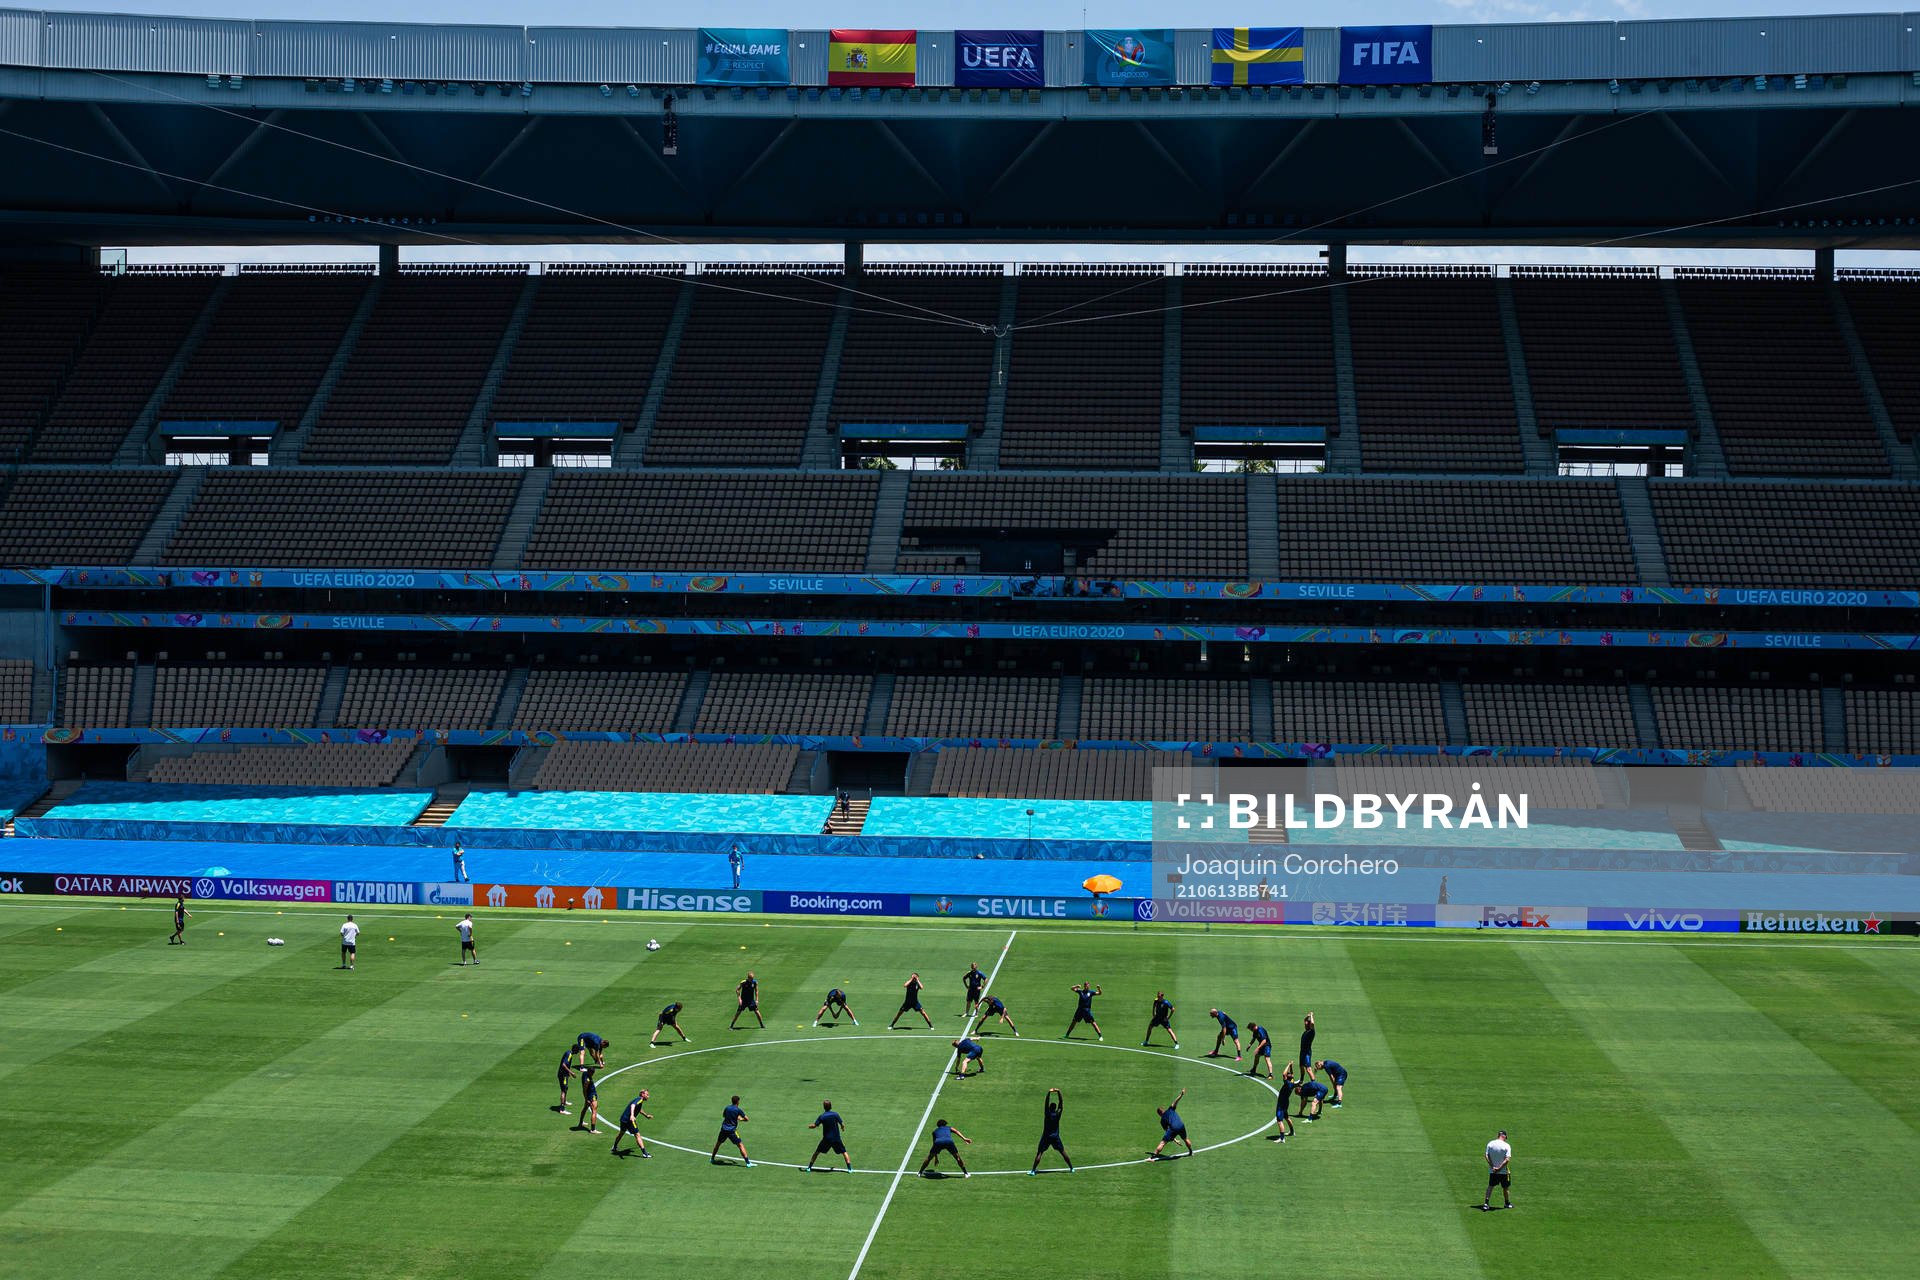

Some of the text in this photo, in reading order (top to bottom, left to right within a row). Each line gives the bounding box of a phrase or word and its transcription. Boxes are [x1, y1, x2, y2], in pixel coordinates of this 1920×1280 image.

[963, 45, 1036, 68] UEFA
[1353, 41, 1420, 66] FIFA
[292, 574, 415, 588] UEFA EURO 2020
[768, 577, 823, 591] SEVILLE
[1298, 584, 1355, 598] SEVILLE
[1736, 590, 1867, 605] UEFA EURO 2020
[332, 616, 385, 629] SEVILLE
[1012, 624, 1125, 639] UEFA EURO 2020
[1764, 634, 1821, 648] SEVILLE
[0, 876, 24, 893] ok
[55, 876, 191, 895] QATAR AIRWAYS
[221, 879, 325, 899] Volkswagen
[335, 882, 413, 903] GAZPROM
[627, 888, 751, 912] Hisense
[790, 894, 882, 912] Booking.com
[977, 898, 1066, 917] SEVILLE
[1165, 901, 1278, 922] Volkswagen
[1338, 902, 1407, 926] 支付宝
[1483, 906, 1550, 928] FedEx
[1624, 908, 1703, 930] vivo
[1747, 912, 1859, 932] Heineken
